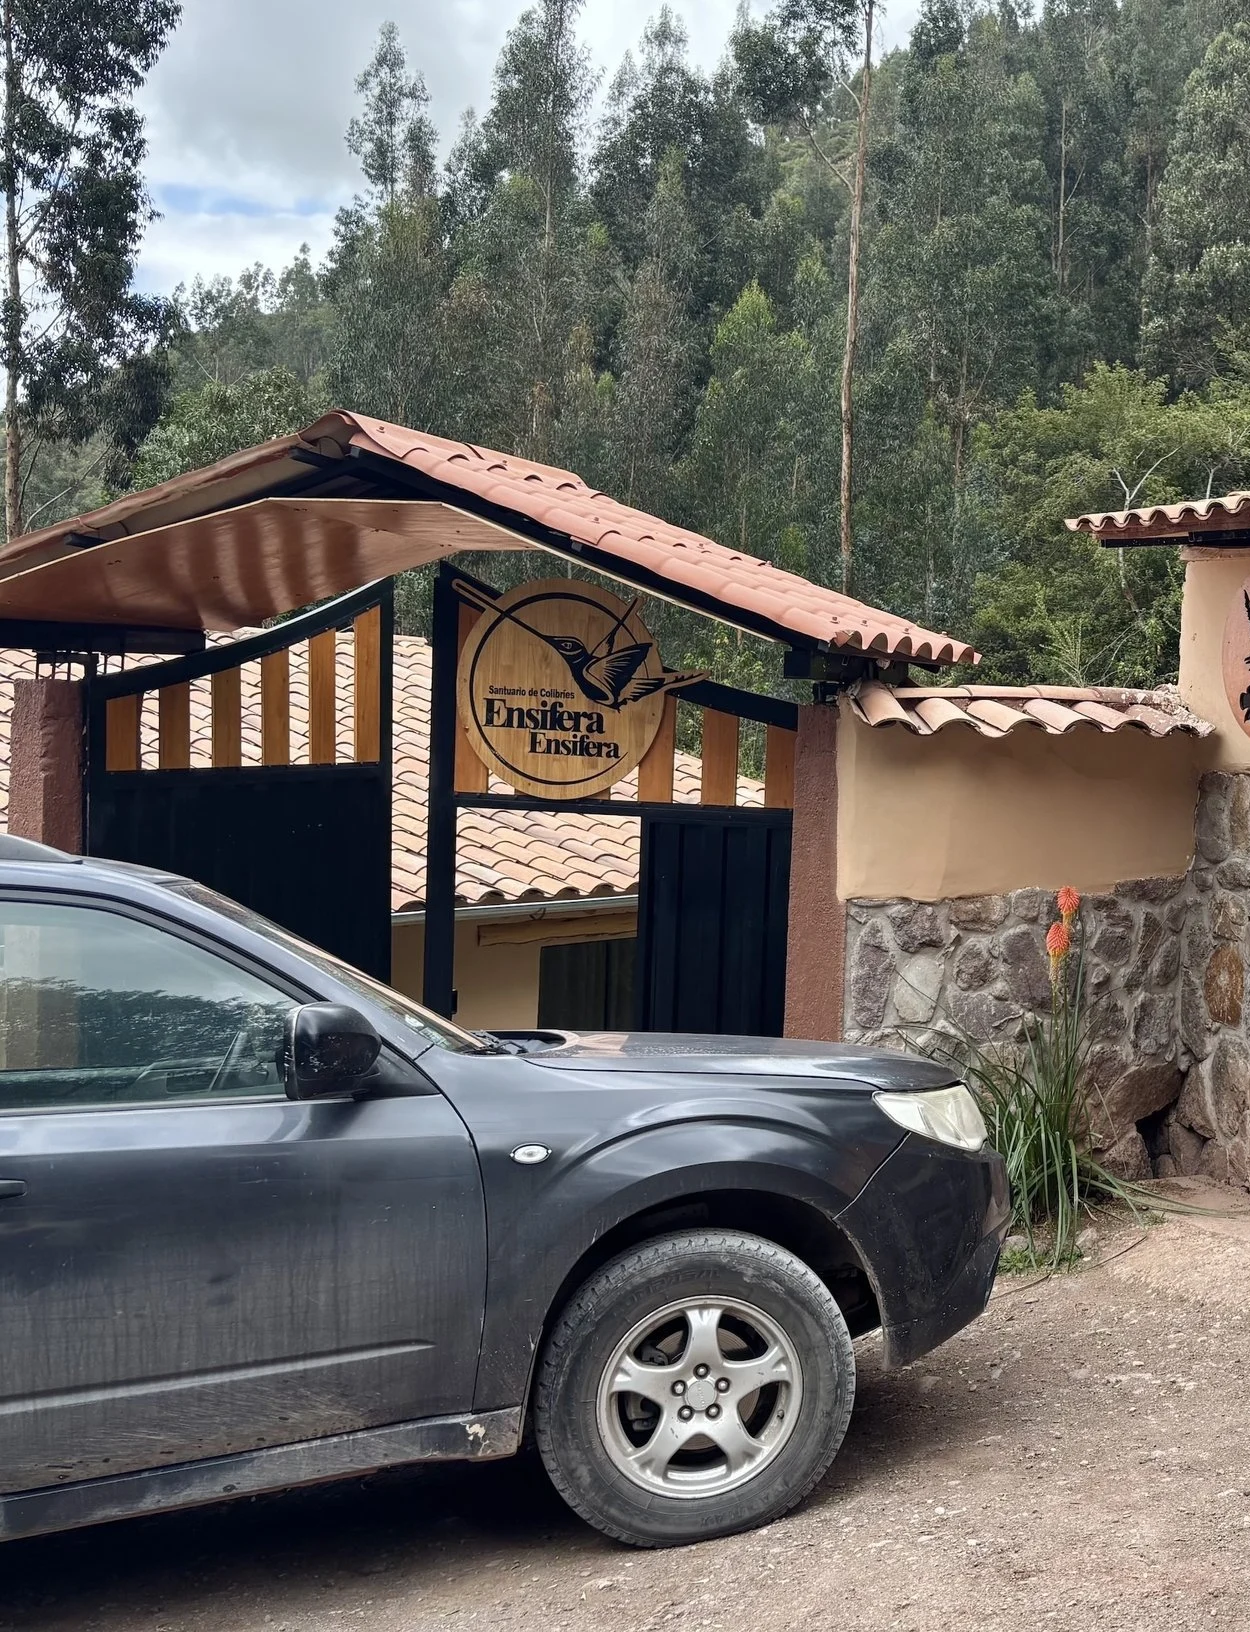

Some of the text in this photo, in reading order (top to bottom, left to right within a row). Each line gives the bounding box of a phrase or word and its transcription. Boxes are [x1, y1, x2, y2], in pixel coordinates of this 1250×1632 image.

[488, 685, 526, 696] Santuario
[528, 688, 538, 697] de
[482, 698, 605, 734] Ensifera
[528, 730, 620, 759] Ensifera
